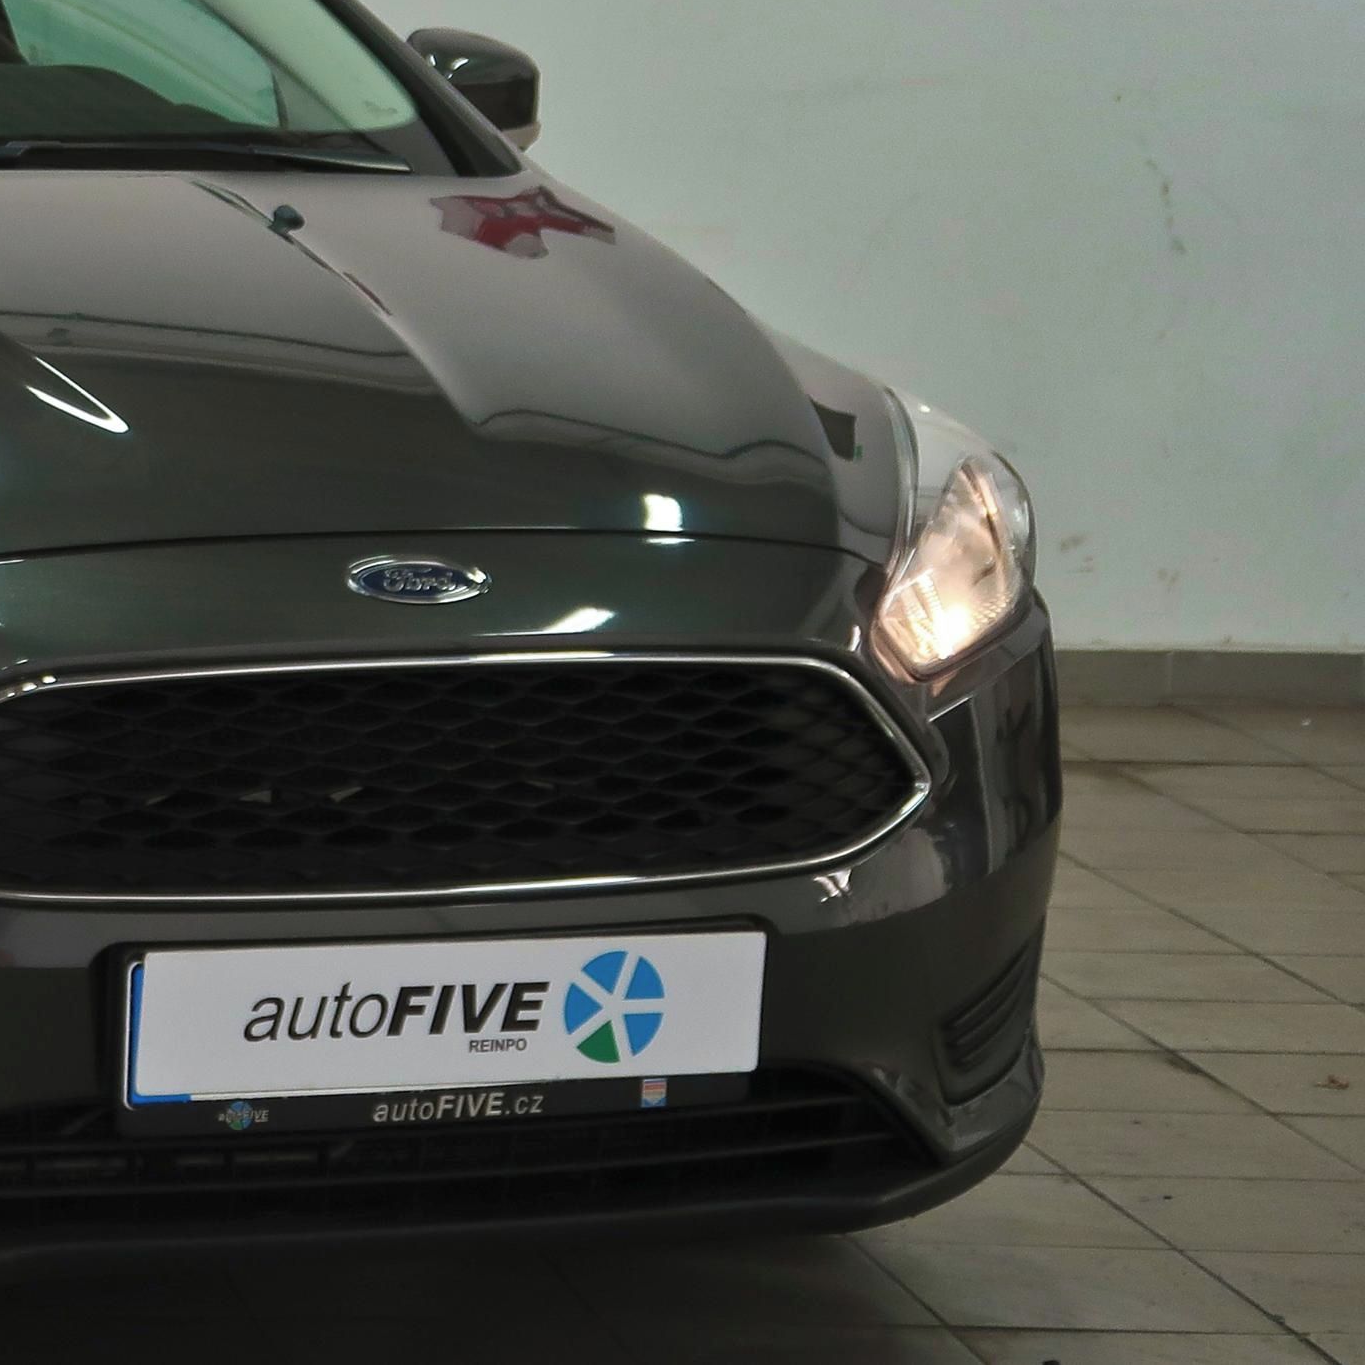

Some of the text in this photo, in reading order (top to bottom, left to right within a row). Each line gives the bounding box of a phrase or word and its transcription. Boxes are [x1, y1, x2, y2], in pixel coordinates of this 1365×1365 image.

[383, 567, 458, 592] Ford
[242, 980, 551, 1043] autoFIVE
[468, 1037, 528, 1054] REINPO
[372, 1092, 545, 1123] autoFIVE.cz
